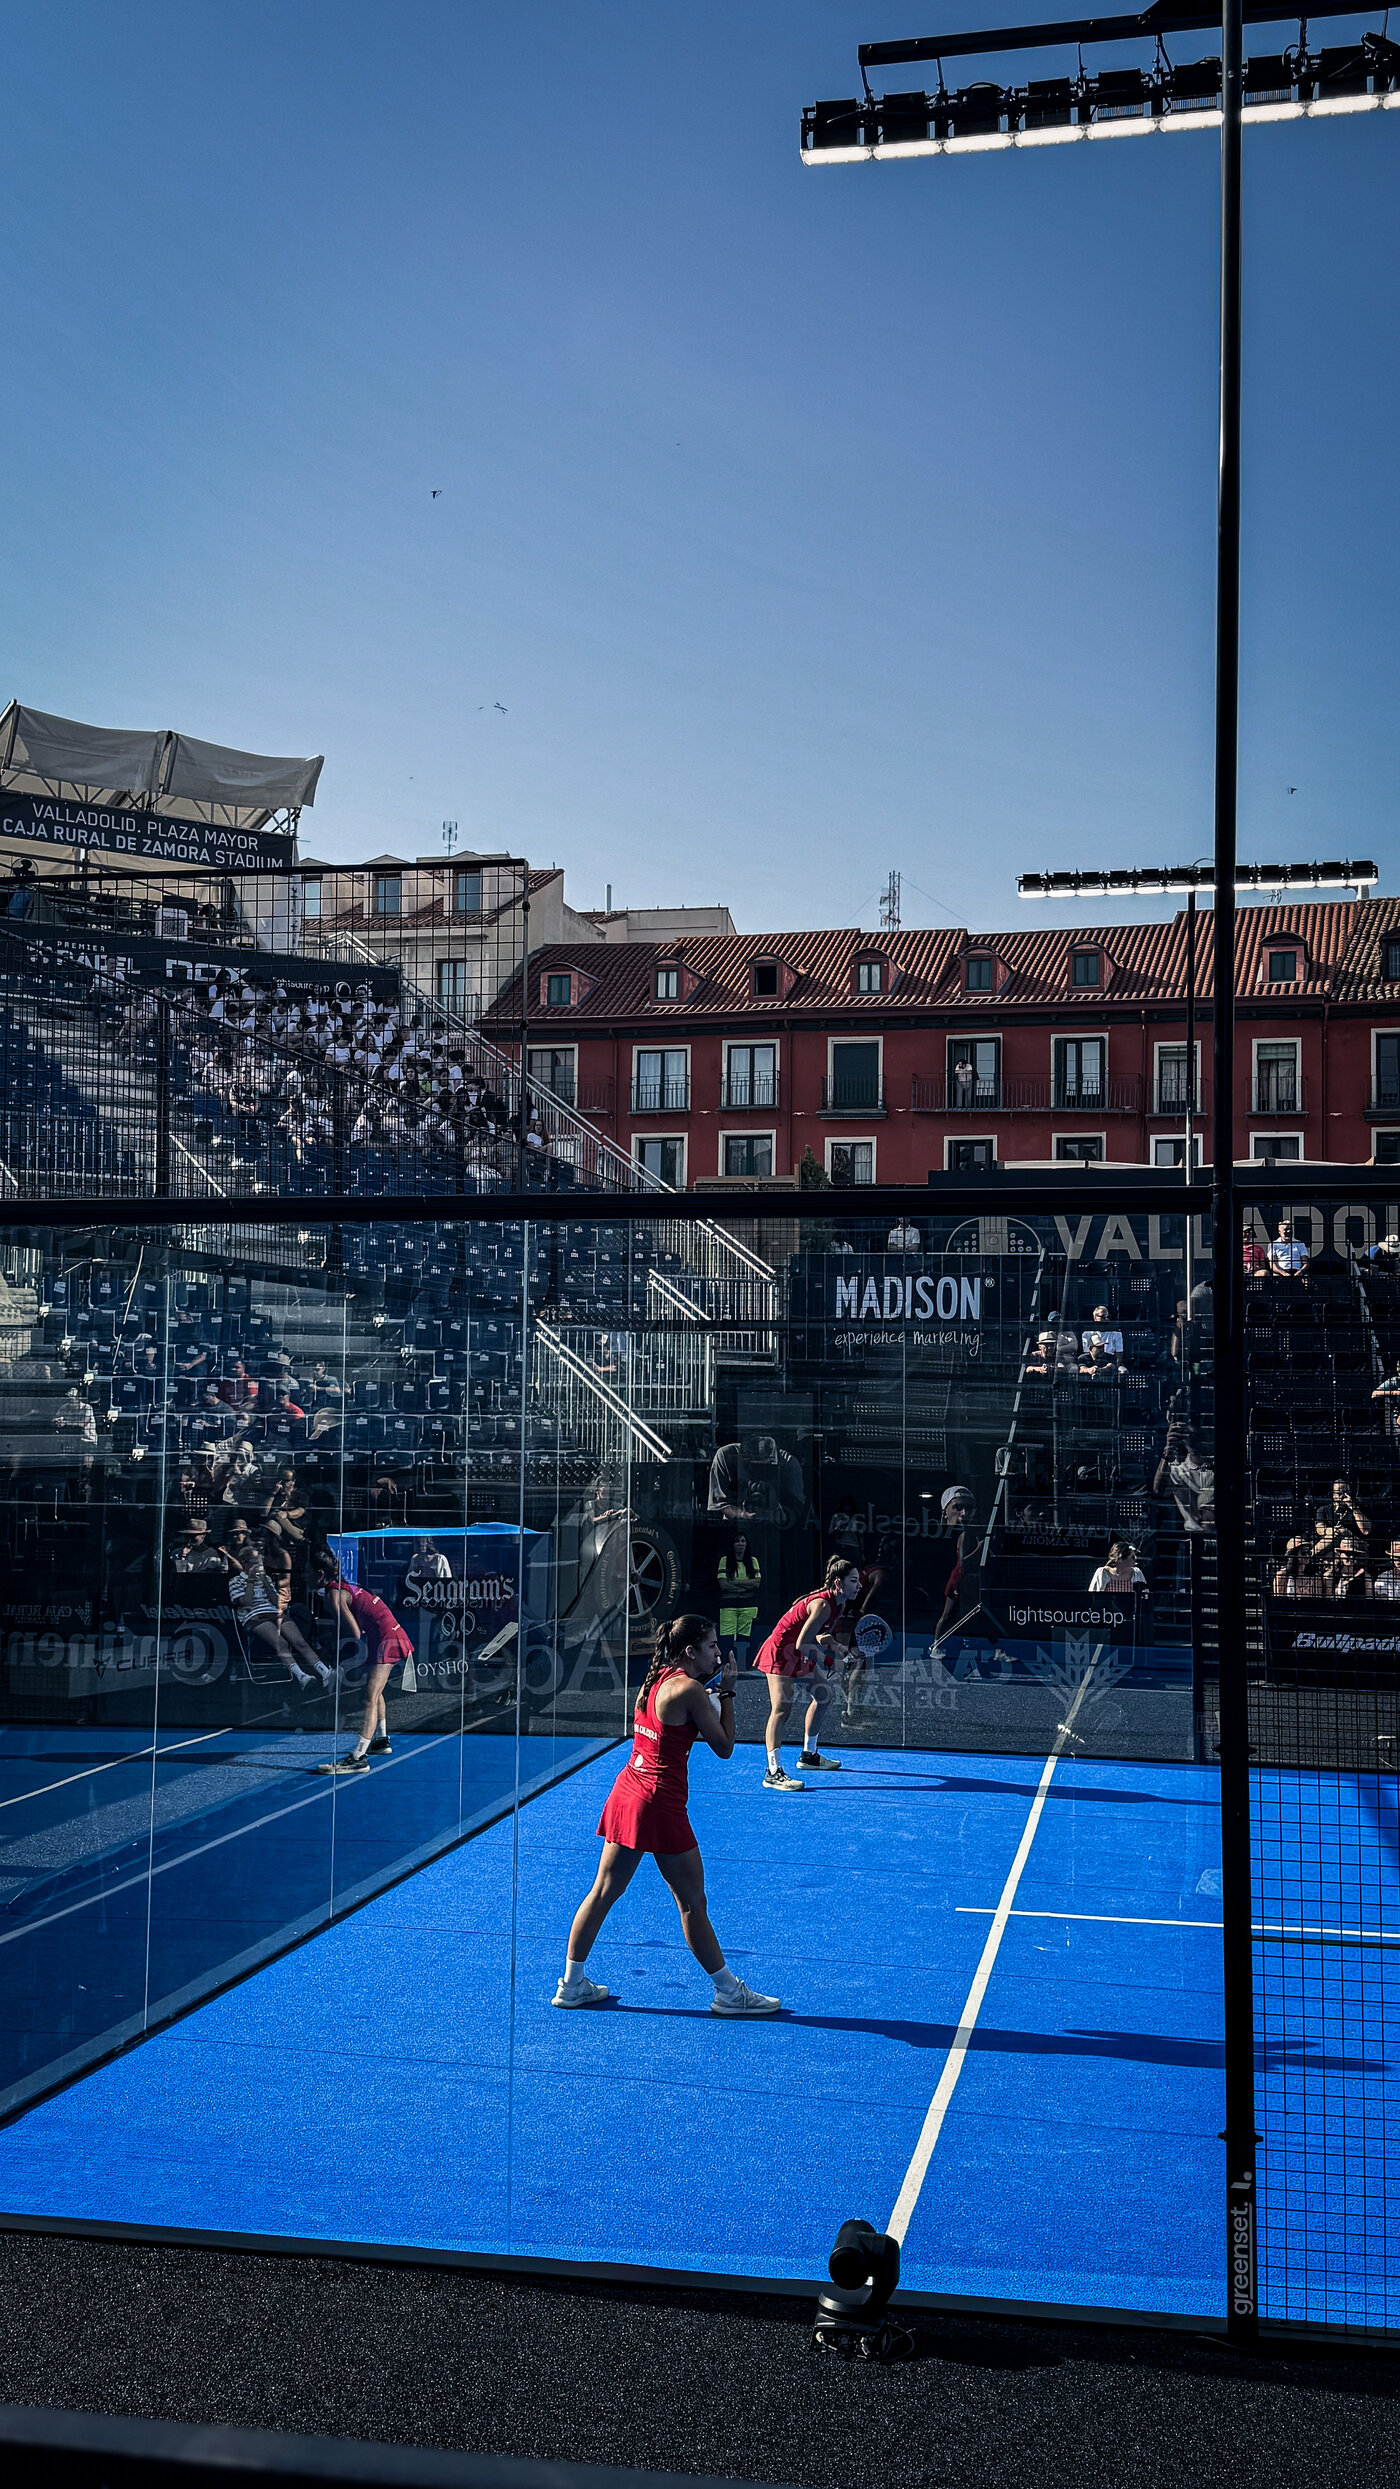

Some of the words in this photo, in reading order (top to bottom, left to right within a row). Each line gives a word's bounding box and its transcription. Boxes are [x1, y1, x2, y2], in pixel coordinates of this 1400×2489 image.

[2, 818, 49, 839] CAJA
[53, 826, 111, 848] RURAL
[115, 835, 137, 851] DE
[142, 838, 211, 863] ZAMORA
[215, 850, 284, 869] STADIUM
[147, 821, 201, 843] PLAZA
[204, 830, 259, 851] MAYOR
[56, 940, 106, 953] PREMIER
[835, 1275, 981, 1320] MADISON
[835, 1330, 906, 1356] experience
[913, 1330, 986, 1357] marketing
[402, 1569, 515, 1609] Seagram's
[416, 1659, 469, 1677] OYSHO
